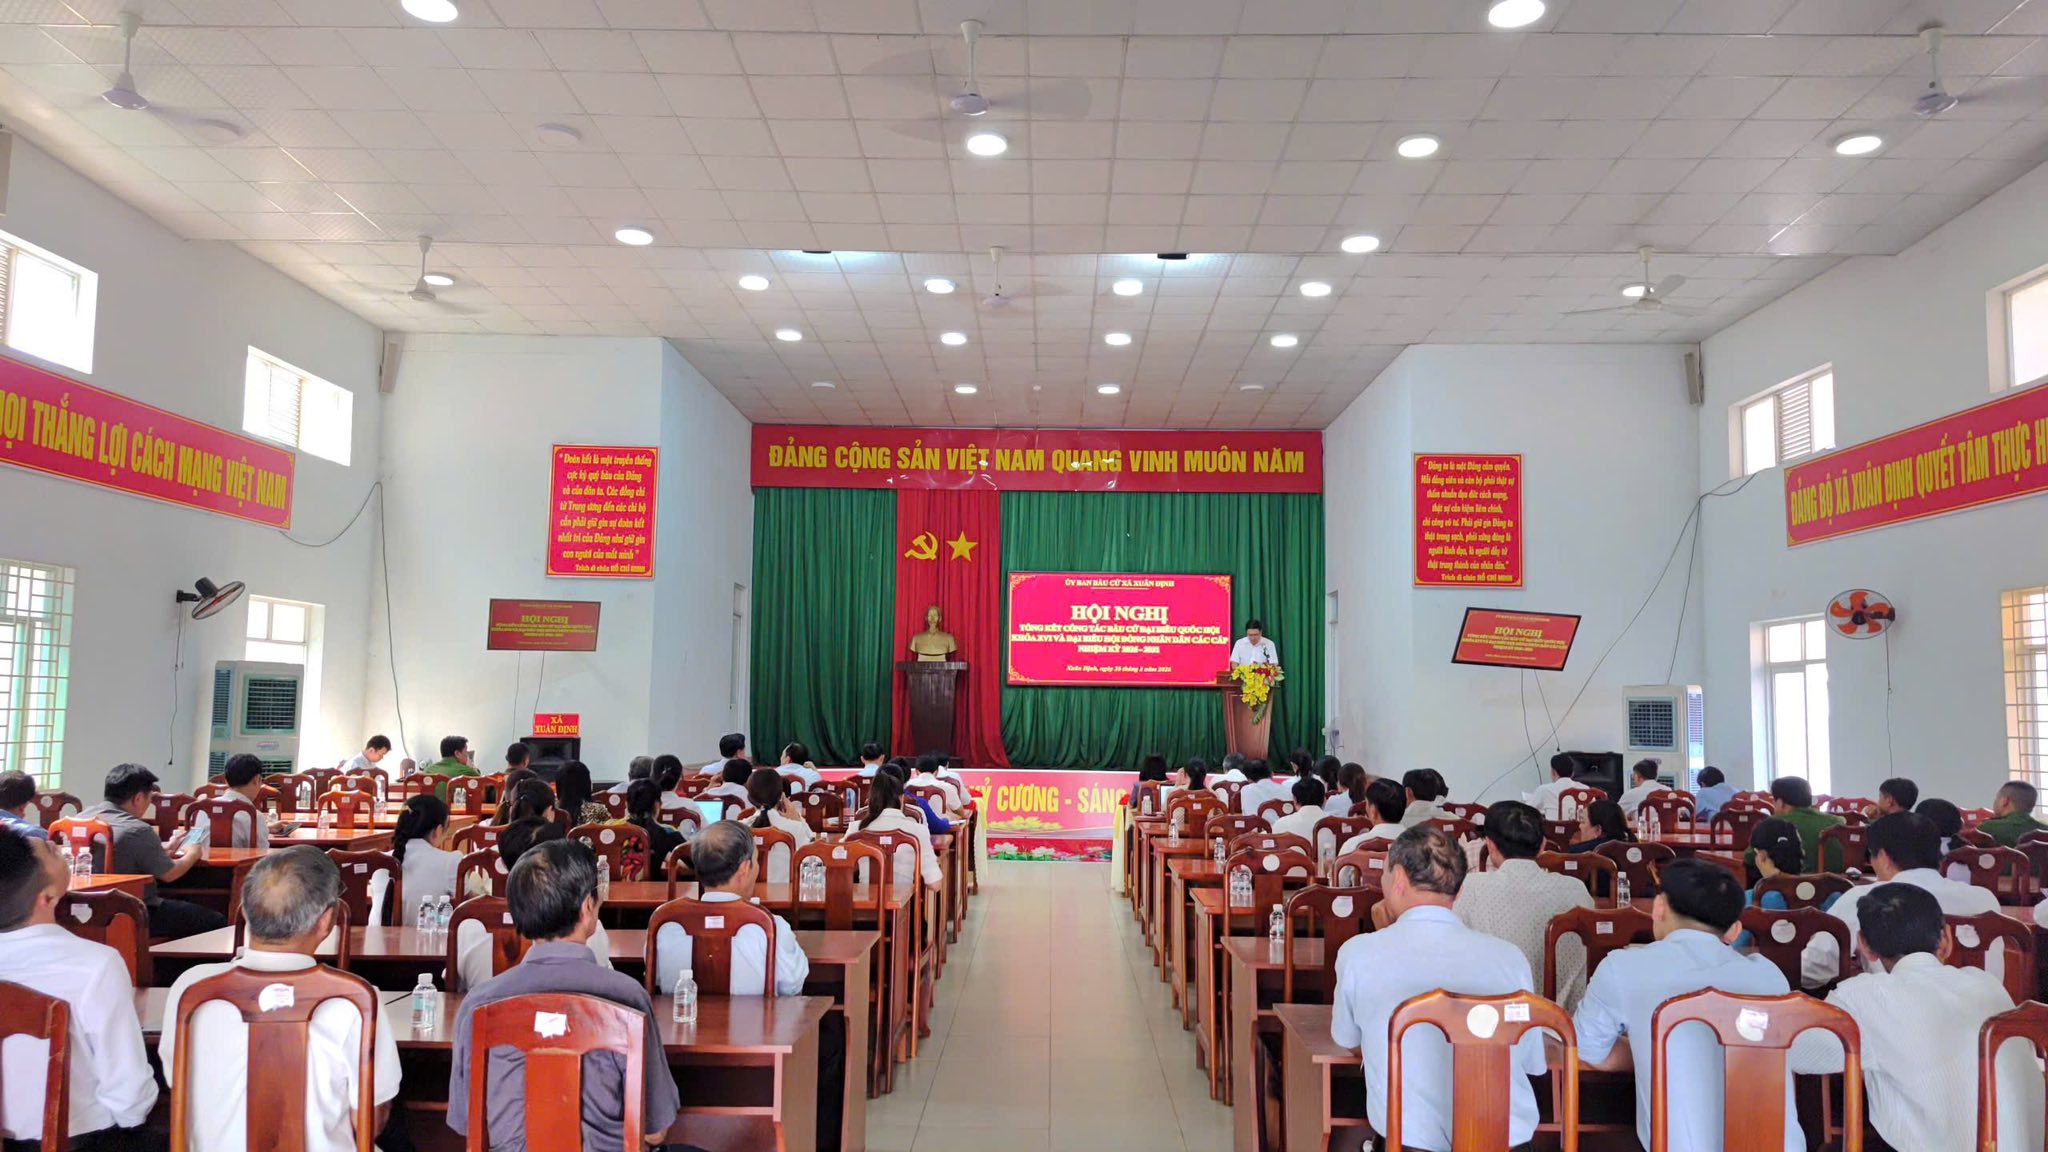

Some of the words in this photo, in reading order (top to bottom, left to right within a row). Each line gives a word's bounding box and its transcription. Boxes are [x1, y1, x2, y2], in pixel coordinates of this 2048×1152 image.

[0, 390, 26, 448] ỌI
[33, 392, 96, 460] THẮNG
[99, 421, 128, 476] LỢI
[131, 426, 174, 483] CÁCH
[178, 446, 221, 496] MẠNG
[226, 456, 255, 507] VIỆT
[256, 468, 286, 509] NAM
[769, 436, 827, 468] ĐẢNG
[835, 442, 891, 473] CỘNG
[897, 439, 940, 471] SẢN
[946, 443, 990, 475] VIỆT
[995, 448, 1045, 471] NAM
[1052, 449, 1122, 473] QUANG
[1130, 450, 1178, 472] VINH
[1184, 445, 1247, 473] MUÔN
[1253, 447, 1304, 473] NĂM
[1791, 476, 1817, 526] ĐẢNG
[1819, 470, 1833, 525] BỘ
[1835, 470, 1850, 515] XÃ
[1852, 461, 1882, 511] XUÂN
[1884, 457, 1914, 510] ĐỊNH
[1916, 433, 1955, 498] QUYẾT
[1958, 431, 1989, 484] TÂM
[1992, 420, 2031, 481] THỰC
[1071, 603, 1110, 623] HỘI
[1114, 606, 1168, 624] NGHỊ
[1495, 626, 1513, 636] HỘI
[1515, 628, 1543, 638] NGHỊ
[535, 724, 556, 734] XUÂN
[558, 726, 578, 735] ĐỊNH
[550, 715, 563, 724] XÃ
[997, 783, 1059, 813] CƯƠNG
